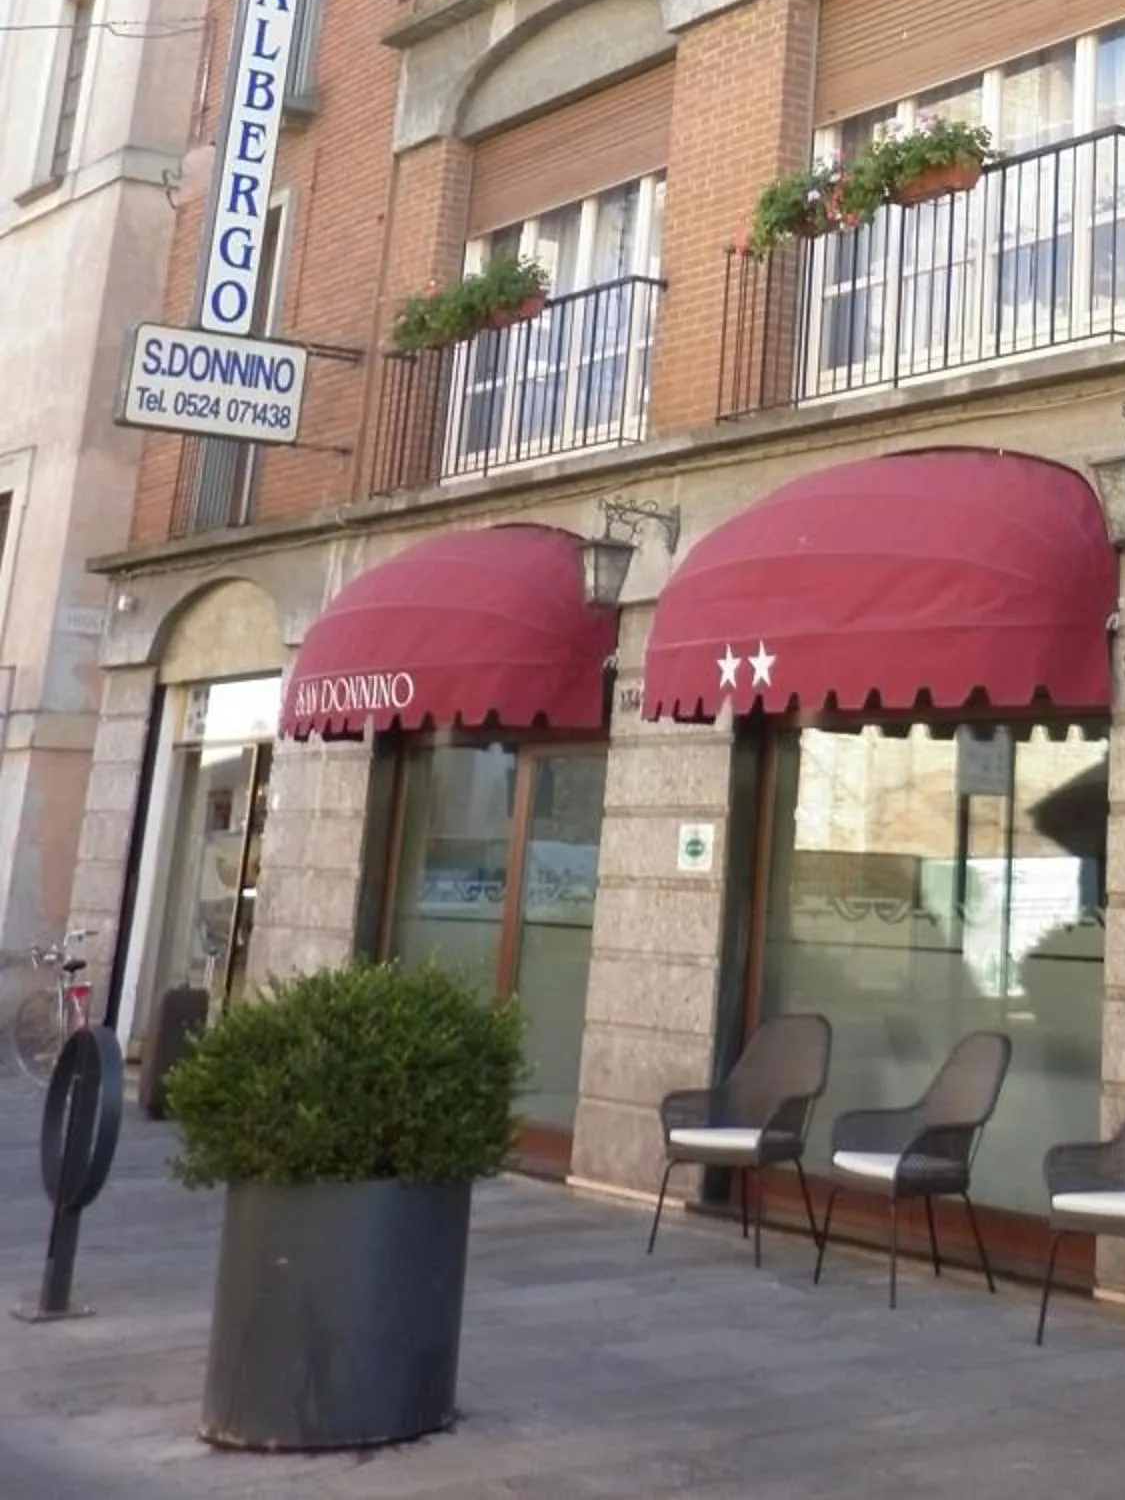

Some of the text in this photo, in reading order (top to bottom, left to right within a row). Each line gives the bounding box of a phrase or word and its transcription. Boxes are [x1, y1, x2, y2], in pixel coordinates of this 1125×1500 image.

[142, 338, 295, 394] S.DONNINO
[136, 386, 292, 430] Tel. 0524 071438
[320, 671, 415, 713] DONNINO
